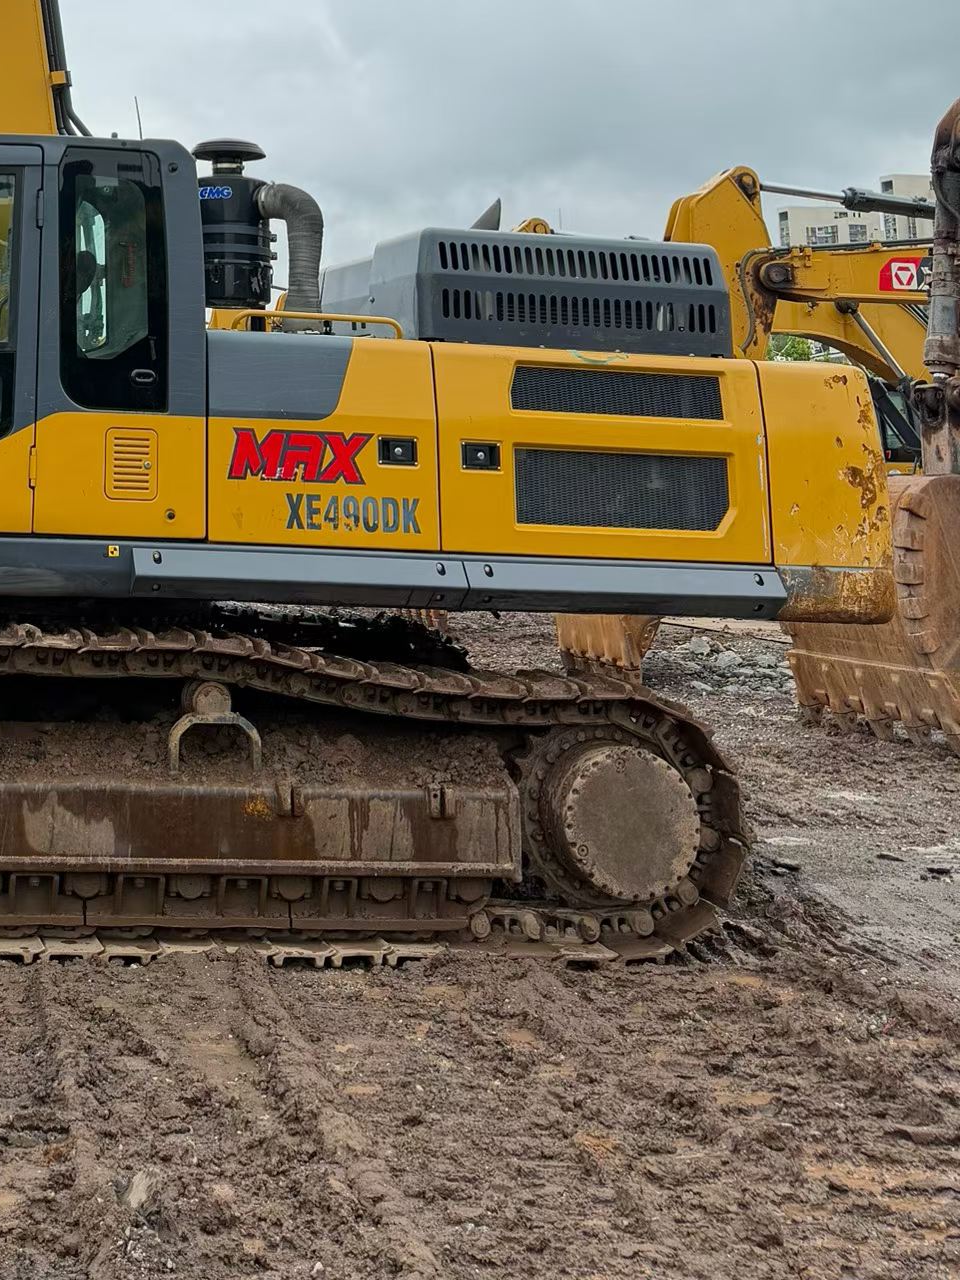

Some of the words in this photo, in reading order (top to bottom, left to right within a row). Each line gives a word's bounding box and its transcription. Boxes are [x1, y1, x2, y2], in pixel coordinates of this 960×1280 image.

[198, 186, 233, 200] CMG
[227, 427, 375, 485] MAX
[286, 493, 421, 534] XE490DK
